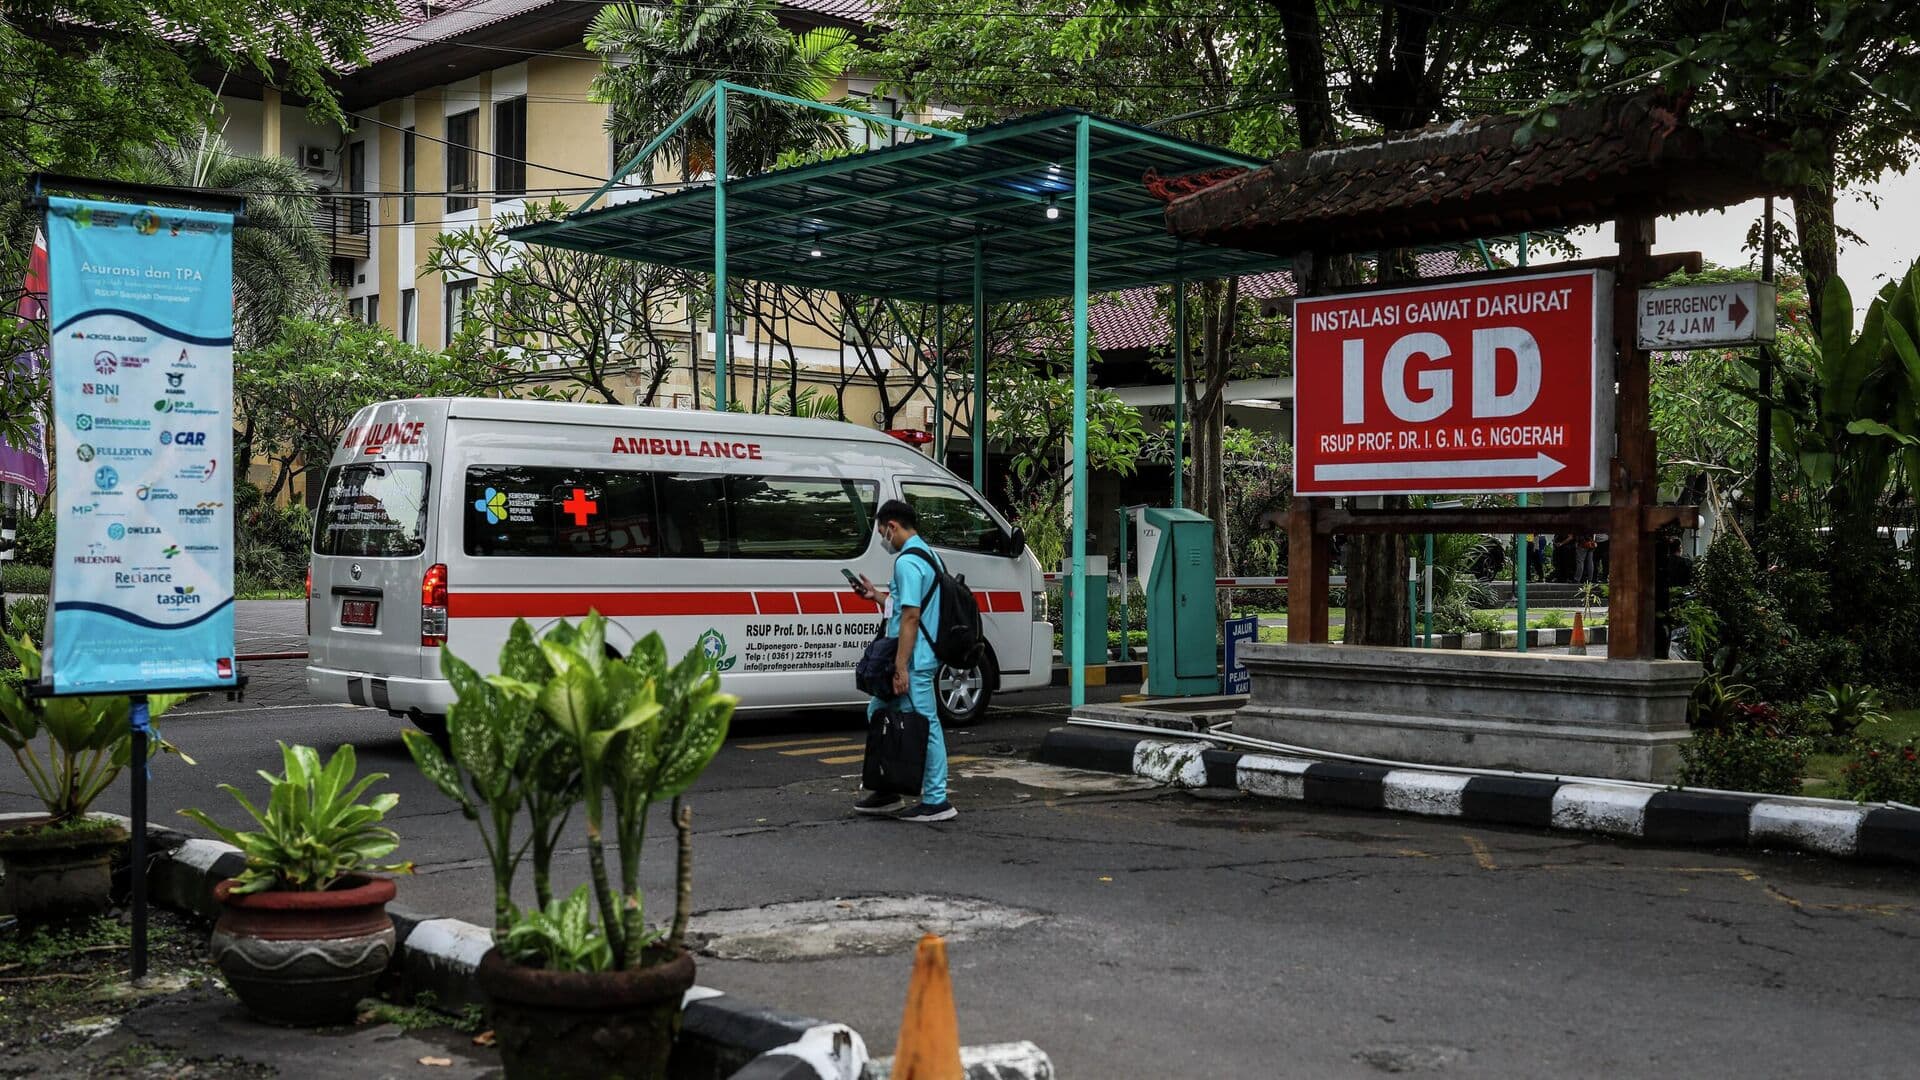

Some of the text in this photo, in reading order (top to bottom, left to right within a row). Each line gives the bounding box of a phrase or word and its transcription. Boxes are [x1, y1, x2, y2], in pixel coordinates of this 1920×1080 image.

[80, 261, 202, 281] Asuransi dan TPA
[1311, 288, 1572, 332] INSTALASI GAWAT DARURAT
[1646, 294, 1727, 316] EMERGENCY
[1658, 316, 1715, 336] 24 JAM
[1342, 326, 1542, 424] IGD
[96, 384, 119, 396] BNI
[174, 432, 206, 446] CAR
[343, 422, 424, 449] AMULANCE
[1320, 426, 1564, 453] RSUP PROF. DR. I. G. N. G. NGOERAH
[96, 448, 152, 456] FULLERTON
[612, 436, 762, 460] AMBULANCE
[127, 526, 162, 534] OWLEXA
[74, 556, 122, 564] PRUDENTIAL
[115, 572, 172, 584] Reliance
[157, 594, 200, 606] taspen
[746, 624, 772, 636] RSUP
[774, 624, 794, 636] Prof.
[797, 624, 808, 636] Dr.
[812, 624, 832, 636] I.G.N
[836, 624, 842, 635] G
[1232, 622, 1252, 636] JALUR
[804, 642, 836, 650] Denpasar
[746, 652, 761, 662] Telp
[772, 652, 789, 660] 0361
[796, 650, 832, 659] 227911-15
[1235, 682, 1248, 694] KAKI
